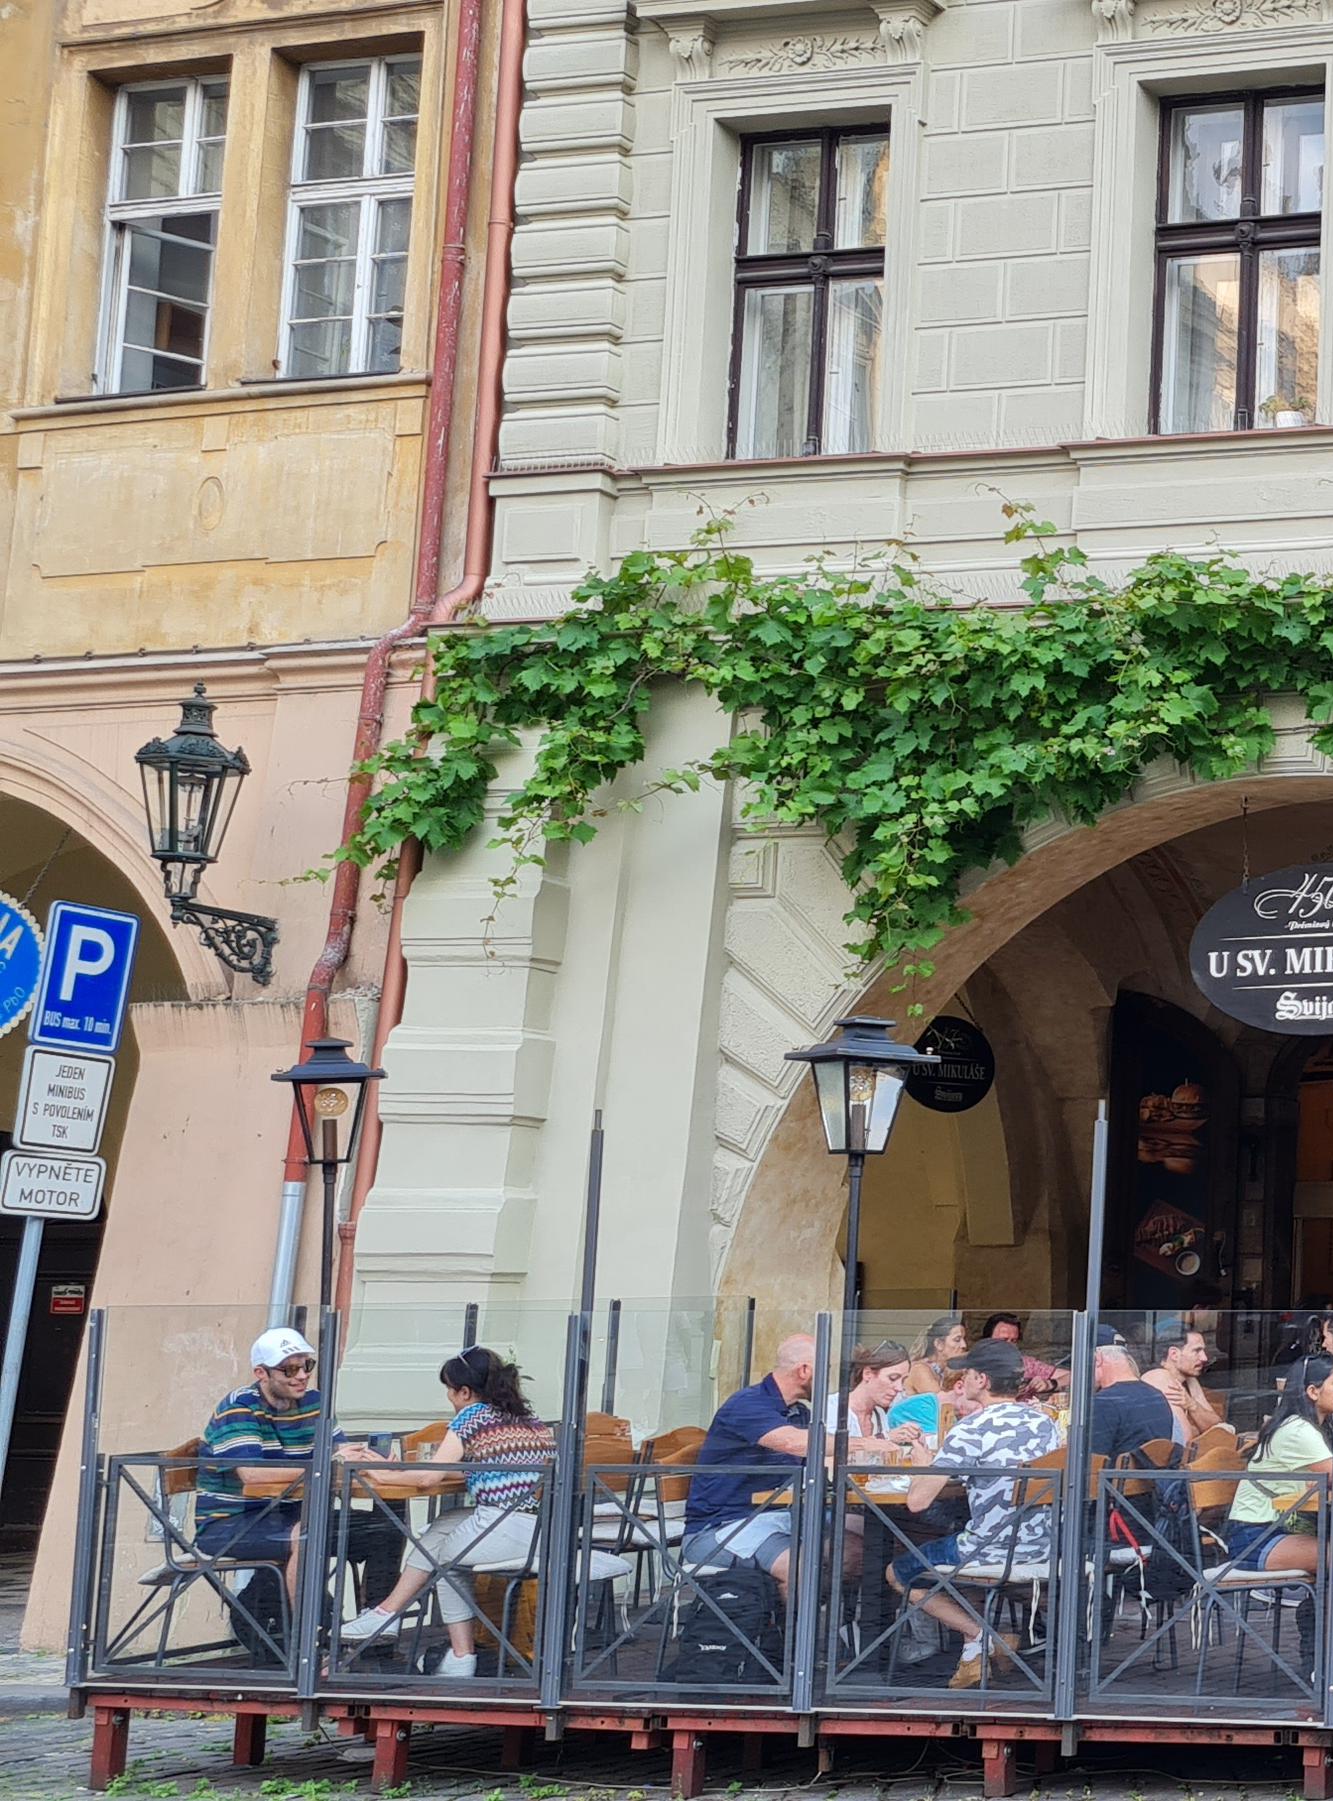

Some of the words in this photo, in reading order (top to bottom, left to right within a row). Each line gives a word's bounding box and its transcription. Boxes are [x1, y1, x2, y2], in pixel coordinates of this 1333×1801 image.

[59, 924, 115, 1001] P
[1208, 951, 1230, 978] U
[1236, 949, 1276, 977] SV.
[43, 1010, 62, 1027] BUS
[83, 1016, 94, 1032] 10
[55, 1065, 86, 1081] JEDEN
[47, 1083, 86, 1101] MINIBUS
[32, 1102, 39, 1115] S
[43, 1103, 95, 1122] POVOLENÍM
[50, 1124, 69, 1139] TSK
[15, 1161, 95, 1184] VYPNĚTE
[18, 1188, 80, 1207] MOTOR
